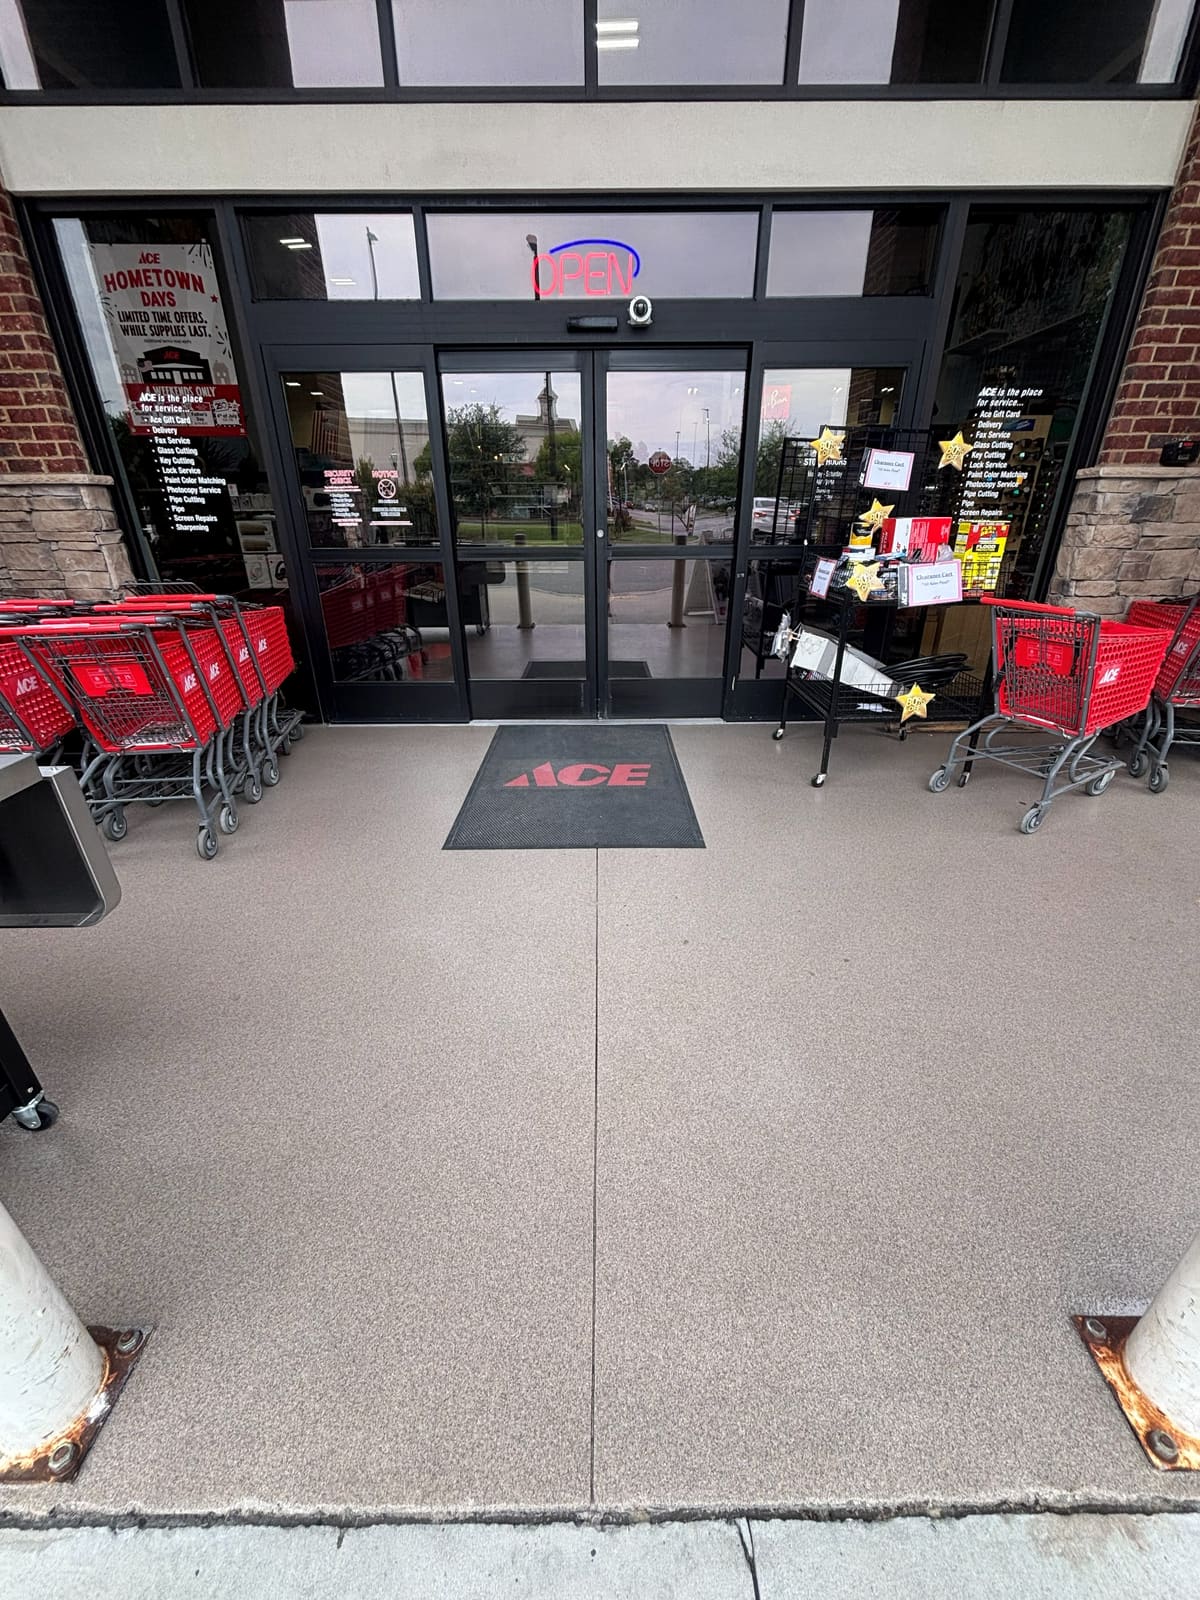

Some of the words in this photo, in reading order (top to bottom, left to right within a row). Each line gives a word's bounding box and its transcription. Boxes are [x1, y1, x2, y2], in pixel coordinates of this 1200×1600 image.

[138, 252, 160, 264] ACE
[530, 252, 633, 296] OPEN
[104, 269, 205, 294] HOMETOWN
[141, 291, 176, 307] DAYS
[117, 311, 149, 323] LIMITED
[152, 311, 172, 323] TIME
[174, 312, 207, 324] OFFERS.
[120, 325, 147, 336] WHILE
[149, 325, 186, 337] SUPPLIES
[188, 325, 211, 337] LAST.
[196, 386, 216, 397] ONLY
[978, 387, 997, 396] ACE
[997, 388, 1005, 396] is
[1007, 388, 1020, 396] the
[1020, 388, 1043, 398] place
[140, 392, 156, 401] ACE
[158, 394, 165, 402] is
[168, 394, 180, 402] the
[182, 395, 203, 403] place
[976, 398, 988, 407] for
[979, 410, 992, 418] Ace
[993, 410, 1005, 418] Gift
[1005, 410, 1021, 418] Card
[163, 416, 175, 424] Gift
[175, 416, 191, 424] Card
[978, 421, 1002, 430] Delivery
[152, 427, 177, 435] Delivery
[154, 436, 166, 444] Fax
[991, 441, 1014, 450] Cutting
[175, 447, 198, 456] Cutting
[984, 451, 1006, 459] Cutting
[160, 457, 171, 465] Key
[172, 457, 195, 466] Cutting
[1001, 471, 1028, 479] Matching
[198, 477, 226, 486] Matching
[167, 486, 197, 494] Photocopy
[199, 486, 221, 494] Service
[963, 490, 976, 498] Pipe
[978, 490, 999, 498] Cutting
[183, 496, 205, 504] Cutting
[171, 505, 185, 513] Pipe
[981, 509, 1003, 517] Repairs
[175, 524, 209, 532] Sharpening
[258, 638, 267, 653] ACE
[1173, 639, 1188, 654] ACE
[239, 647, 249, 663] ACE
[210, 662, 220, 680] ACE
[1100, 668, 1120, 684] ACE
[16, 675, 38, 696] ACE
[184, 673, 196, 693] ACE
[504, 761, 651, 787] ACE
